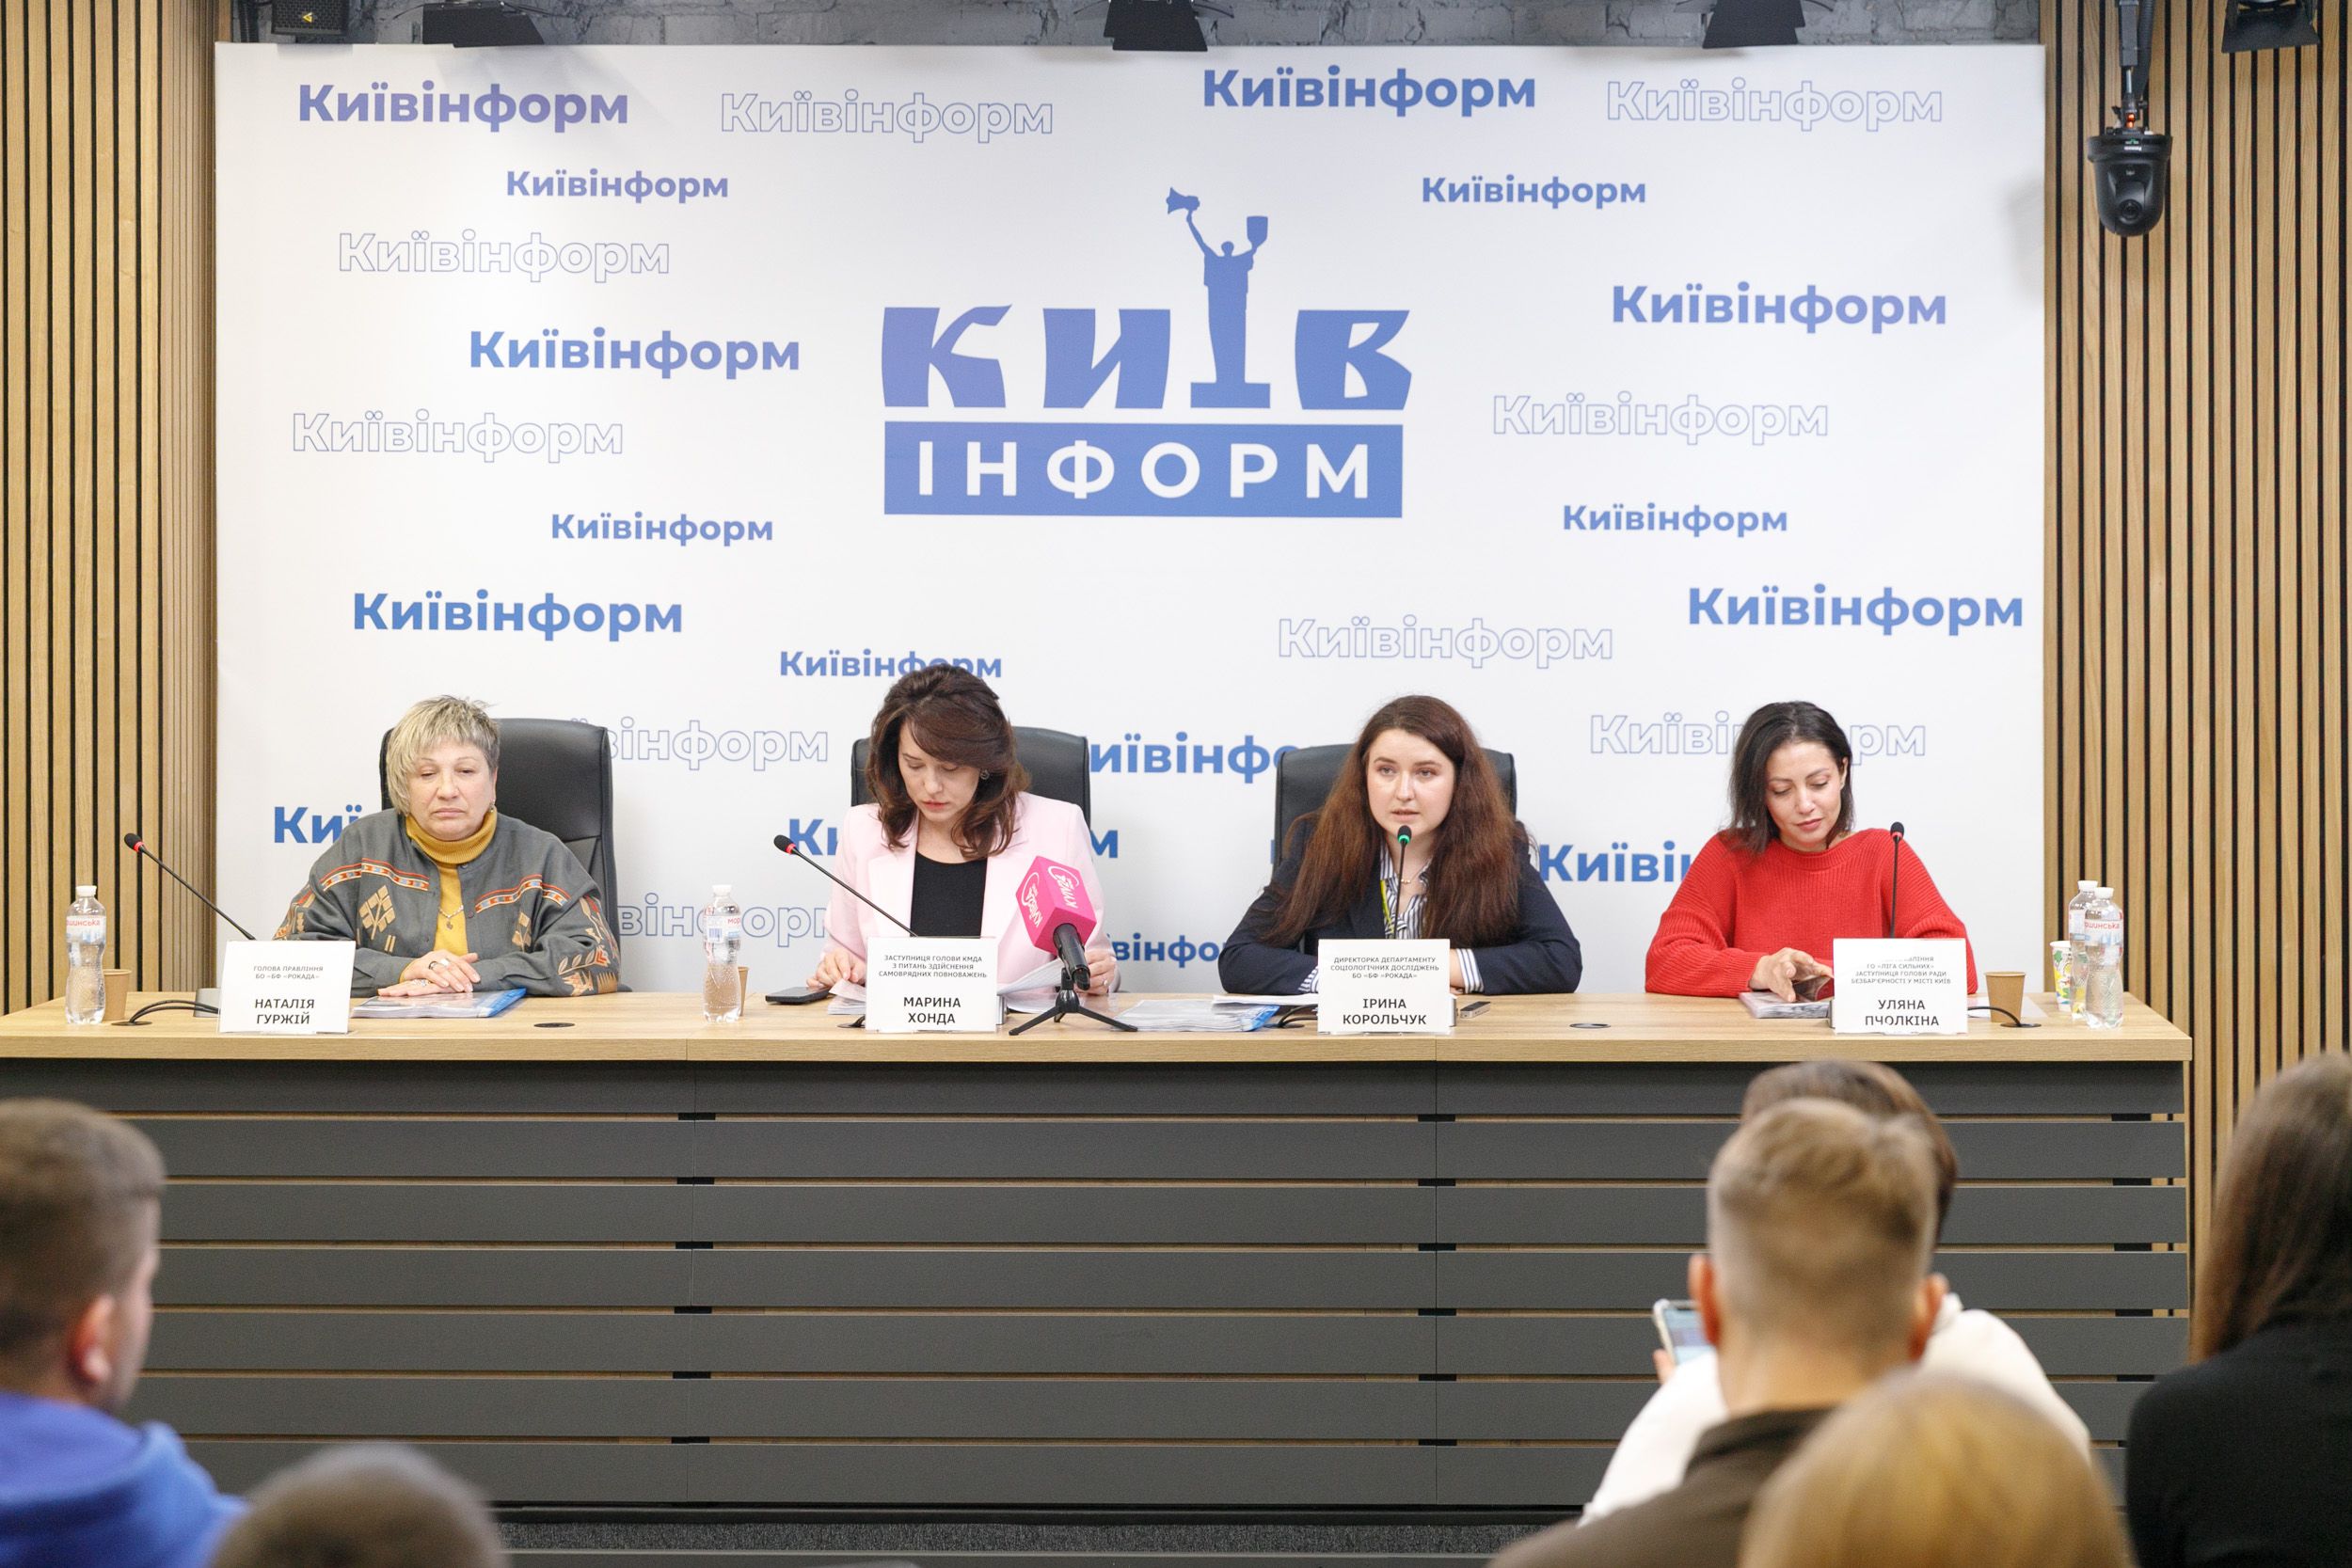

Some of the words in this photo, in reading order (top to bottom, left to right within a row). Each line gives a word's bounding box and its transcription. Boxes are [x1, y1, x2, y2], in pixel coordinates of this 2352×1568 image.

[300, 81, 627, 132] Київінформ
[722, 89, 1053, 144] Київінформ
[1204, 65, 1535, 118] Київінформ
[1607, 77, 1942, 132] Київінформ
[508, 168, 727, 203] Київінформ
[1422, 174, 1646, 210] Київінформ
[339, 229, 670, 284] Київінформ
[1613, 281, 1947, 334] Київінформ
[470, 326, 799, 380] Київінформ
[293, 408, 623, 464] Київінформ
[1493, 390, 1828, 446] Київінформ
[918, 440, 1368, 499] ІНФОРМ
[552, 512, 772, 546] Київінформ
[1565, 502, 1788, 538] Київінформ
[354, 589, 682, 642] Київінформ
[1689, 583, 2023, 637] Київінформ
[1279, 614, 1613, 670] Київінформ
[255, 999, 315, 1009] НАТАЛІЯ
[256, 1012, 310, 1024] ГУРЖІЙ
[903, 997, 961, 1008] МАРИНА
[908, 1012, 956, 1025] ХОНДА
[1343, 1014, 1427, 1024] КОРОЛЬЧУК
[1362, 998, 1406, 1009] ІРИНА
[1865, 1015, 1939, 1026] ПЧОЛКІНА
[1878, 1000, 1926, 1010] УЛЯНА
